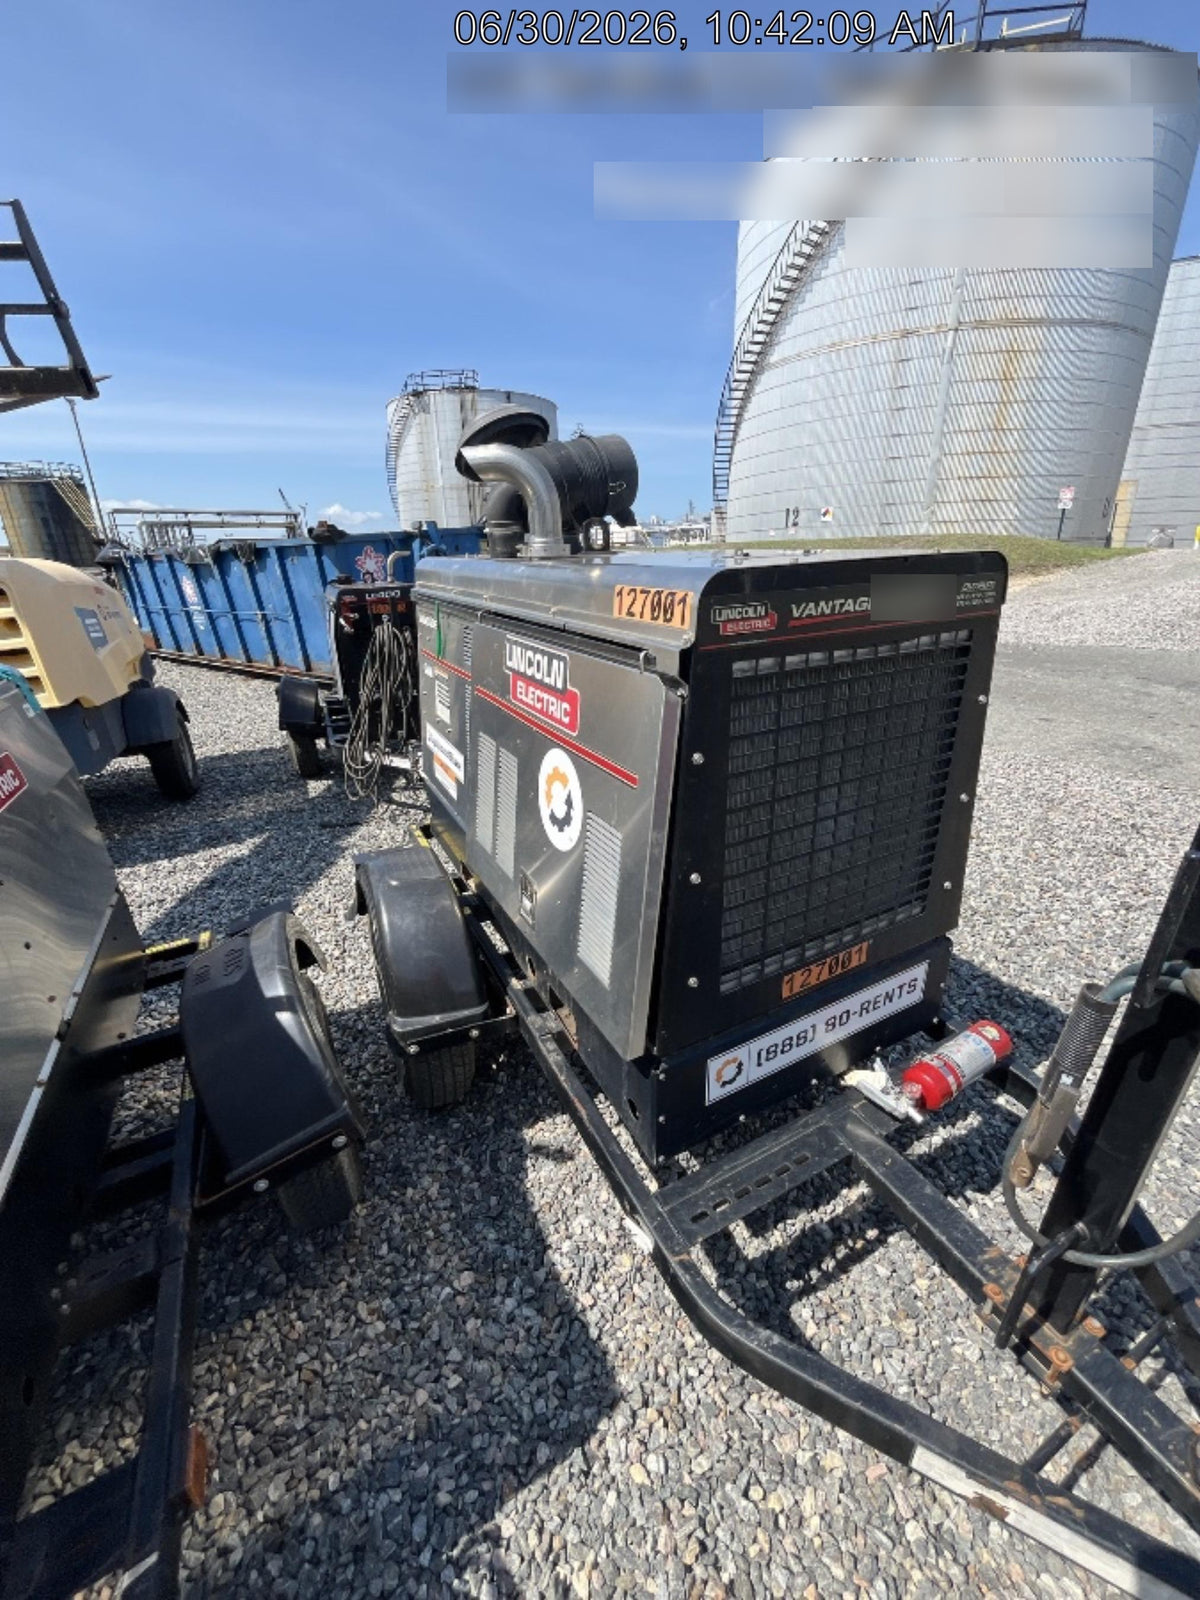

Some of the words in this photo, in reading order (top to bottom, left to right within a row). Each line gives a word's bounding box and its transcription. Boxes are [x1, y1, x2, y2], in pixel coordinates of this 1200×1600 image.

[616, 587, 689, 627] 127001
[715, 605, 766, 621] LINCOLN
[726, 618, 771, 632] ELECTRIC
[505, 642, 565, 690] LINCOLN
[517, 681, 571, 724] ELECTRIC
[784, 945, 864, 995] 127001
